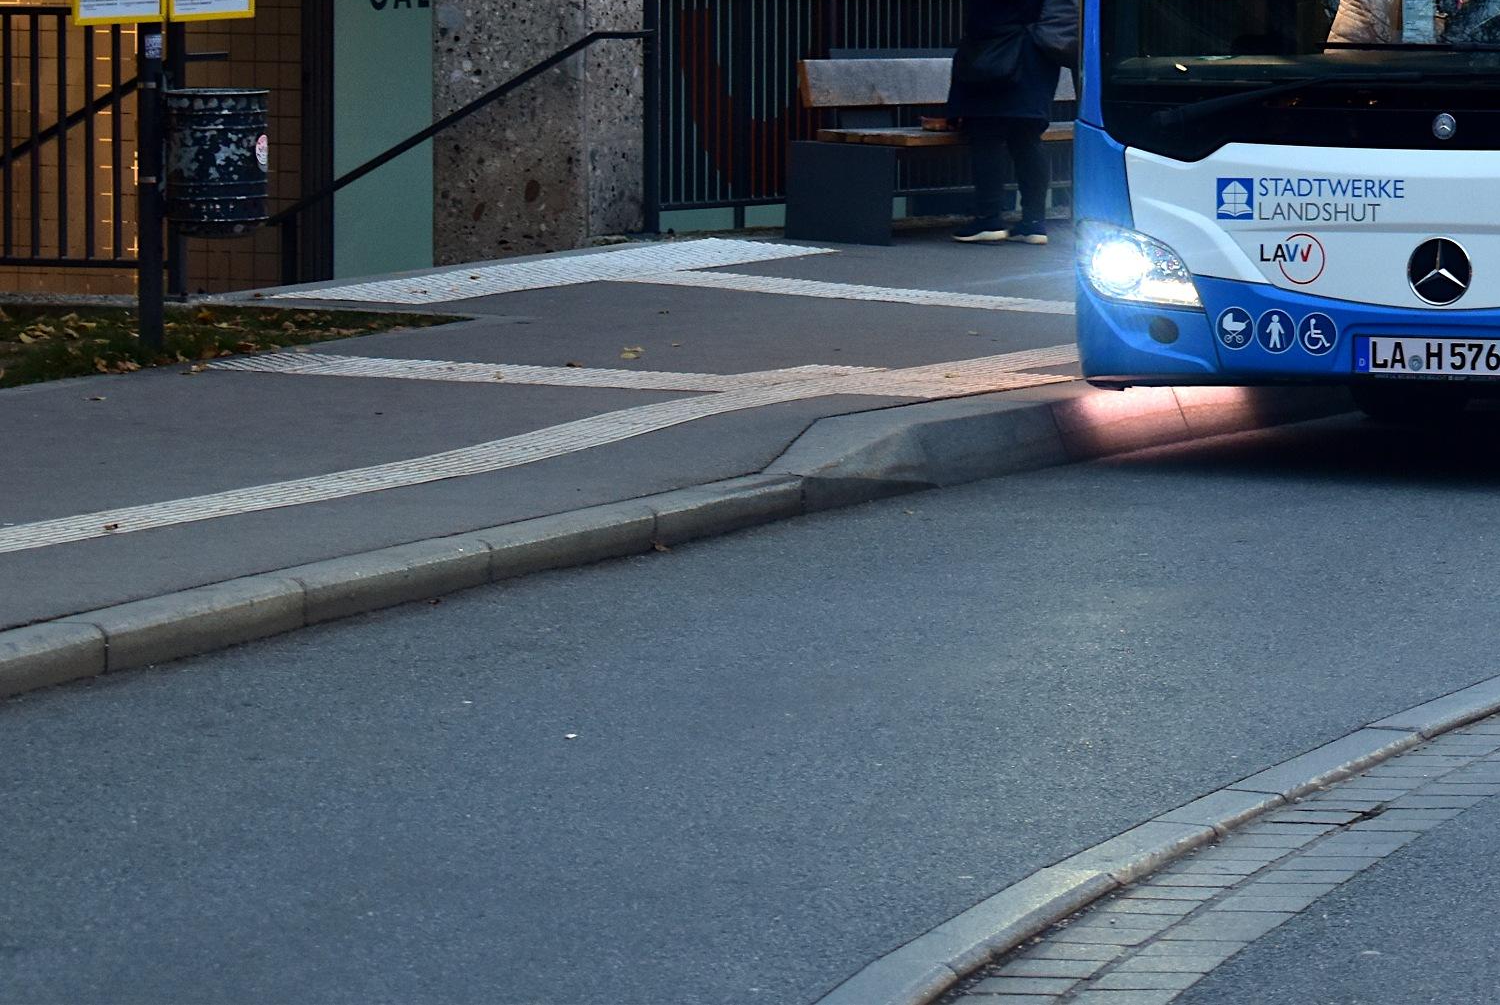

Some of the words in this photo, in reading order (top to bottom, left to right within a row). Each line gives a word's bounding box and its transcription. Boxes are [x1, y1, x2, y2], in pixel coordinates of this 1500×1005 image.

[1258, 177, 1405, 198] STADTWERKE
[1258, 202, 1381, 222] LANDSHUT
[1371, 341, 1406, 370] LA
